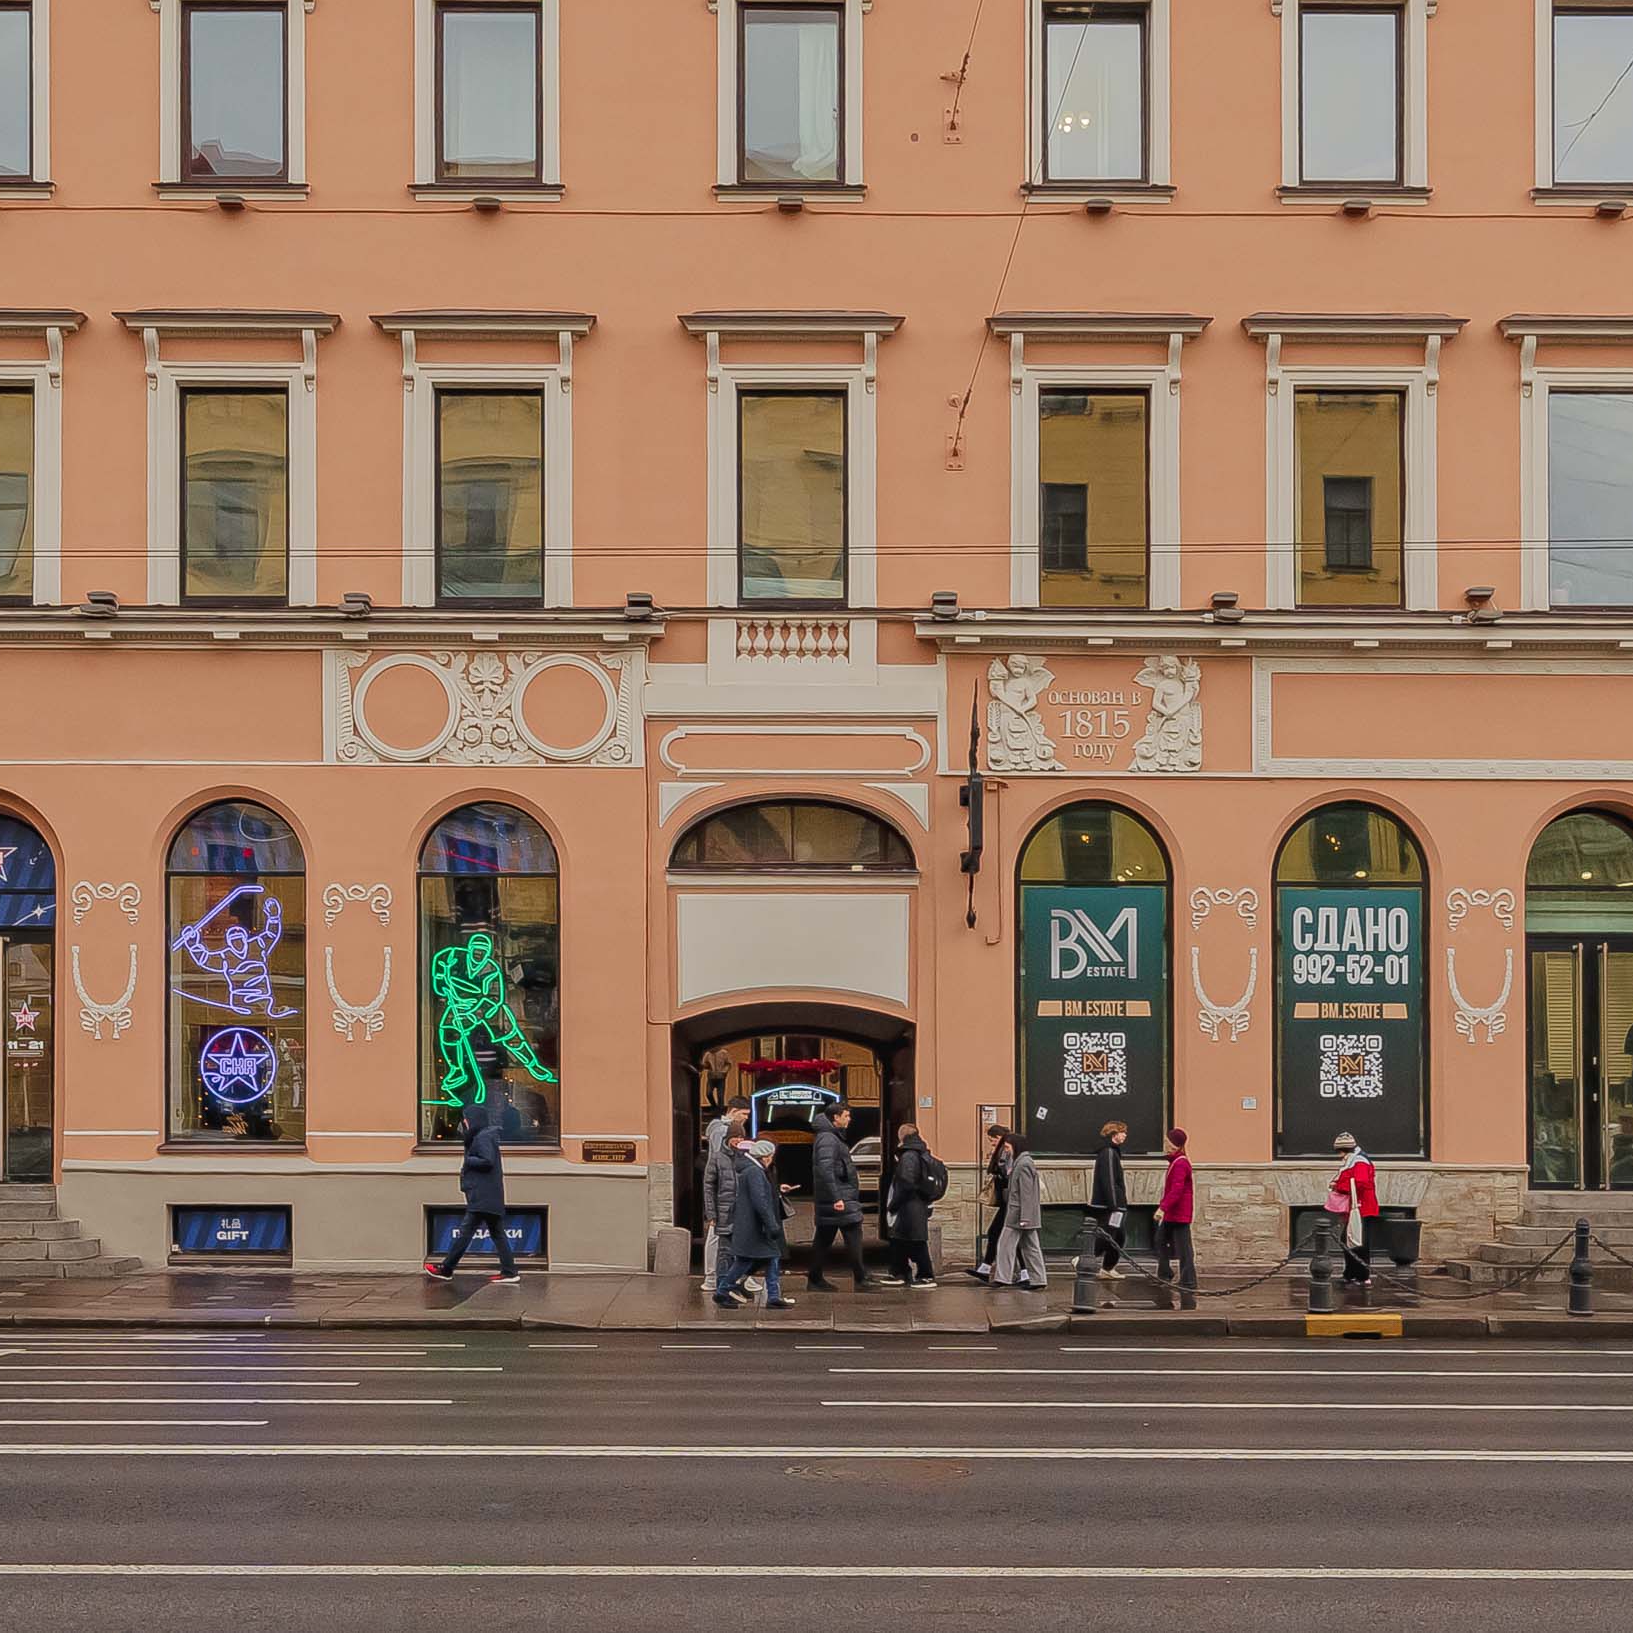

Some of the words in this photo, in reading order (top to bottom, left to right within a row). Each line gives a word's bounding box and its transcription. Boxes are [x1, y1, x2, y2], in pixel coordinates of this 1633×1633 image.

[1048, 689, 1124, 705] основан
[1131, 691, 1141, 706] в
[1058, 710, 1131, 738] 1815
[1073, 743, 1116, 764] году
[1292, 906, 1409, 952] СДАНО
[1050, 907, 1138, 979] BM
[1087, 967, 1126, 978] ESTATE
[1293, 954, 1409, 985] 992-52-01
[1064, 1001, 1125, 1017] BM.ESTATE
[1321, 1004, 1381, 1019] BM.ESTATE
[219, 1057, 257, 1076] СКА
[216, 1230, 250, 1240] GIFT
[452, 1228, 523, 1239] ПДАКИ
